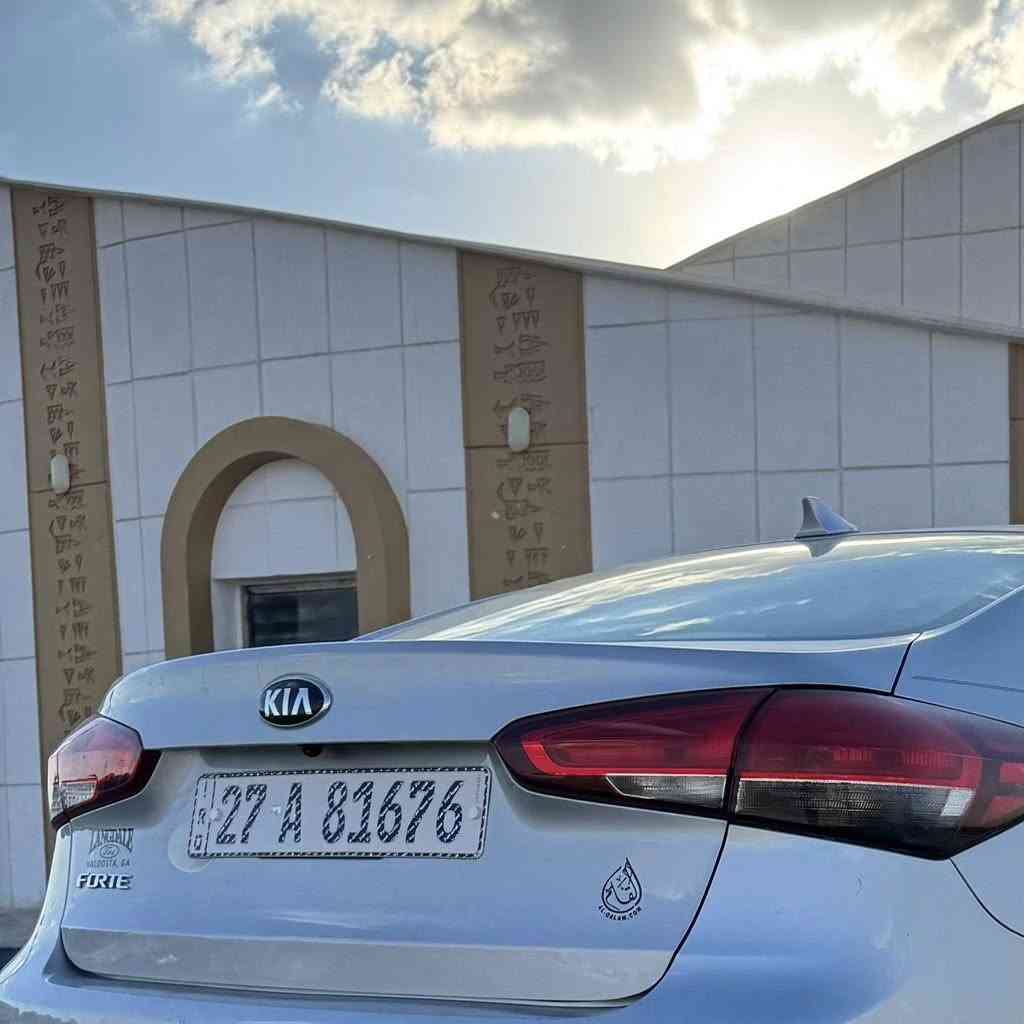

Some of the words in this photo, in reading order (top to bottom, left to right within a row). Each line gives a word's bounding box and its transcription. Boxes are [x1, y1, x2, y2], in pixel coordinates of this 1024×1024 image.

[264, 687, 313, 717] KIA
[216, 784, 268, 844] 27
[278, 782, 302, 843] A
[322, 780, 464, 844] 81676
[76, 872, 132, 889] FORTE
